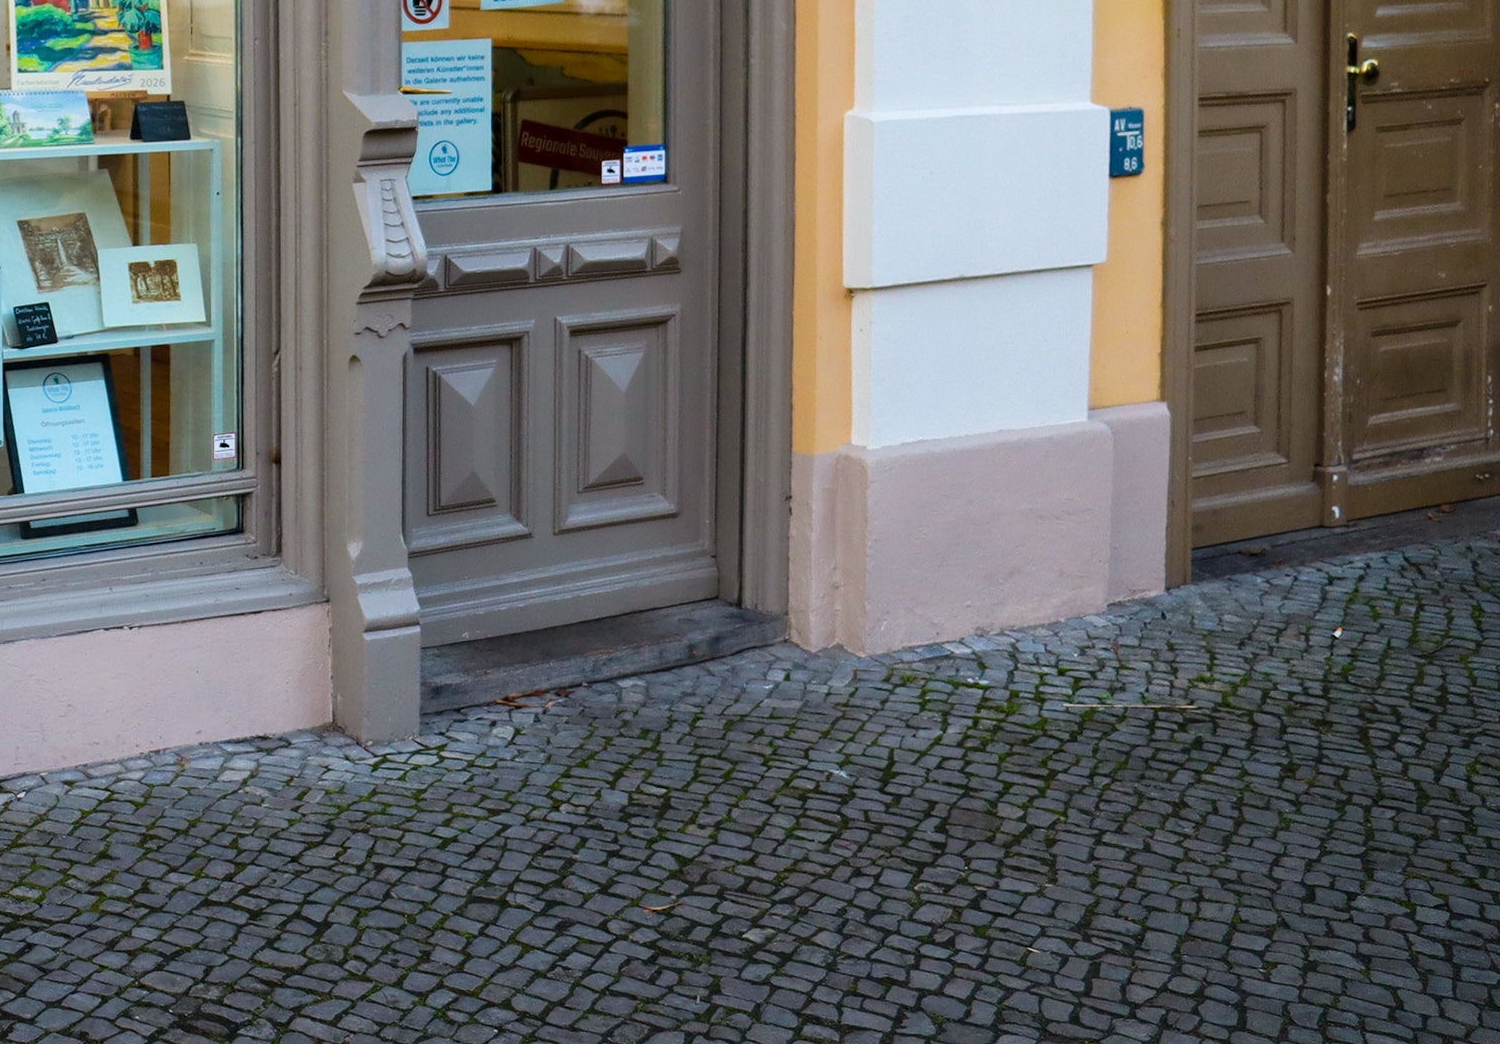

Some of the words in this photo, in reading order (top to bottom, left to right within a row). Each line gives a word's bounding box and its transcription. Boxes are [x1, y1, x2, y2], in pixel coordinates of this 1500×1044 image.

[430, 55, 455, 63] können
[140, 77, 166, 88] 2026
[431, 97, 460, 106] currently
[440, 109, 452, 117] any
[453, 106, 485, 115] additional
[419, 119, 434, 127] tists
[443, 118, 454, 126] the
[521, 131, 577, 156] Regionale
